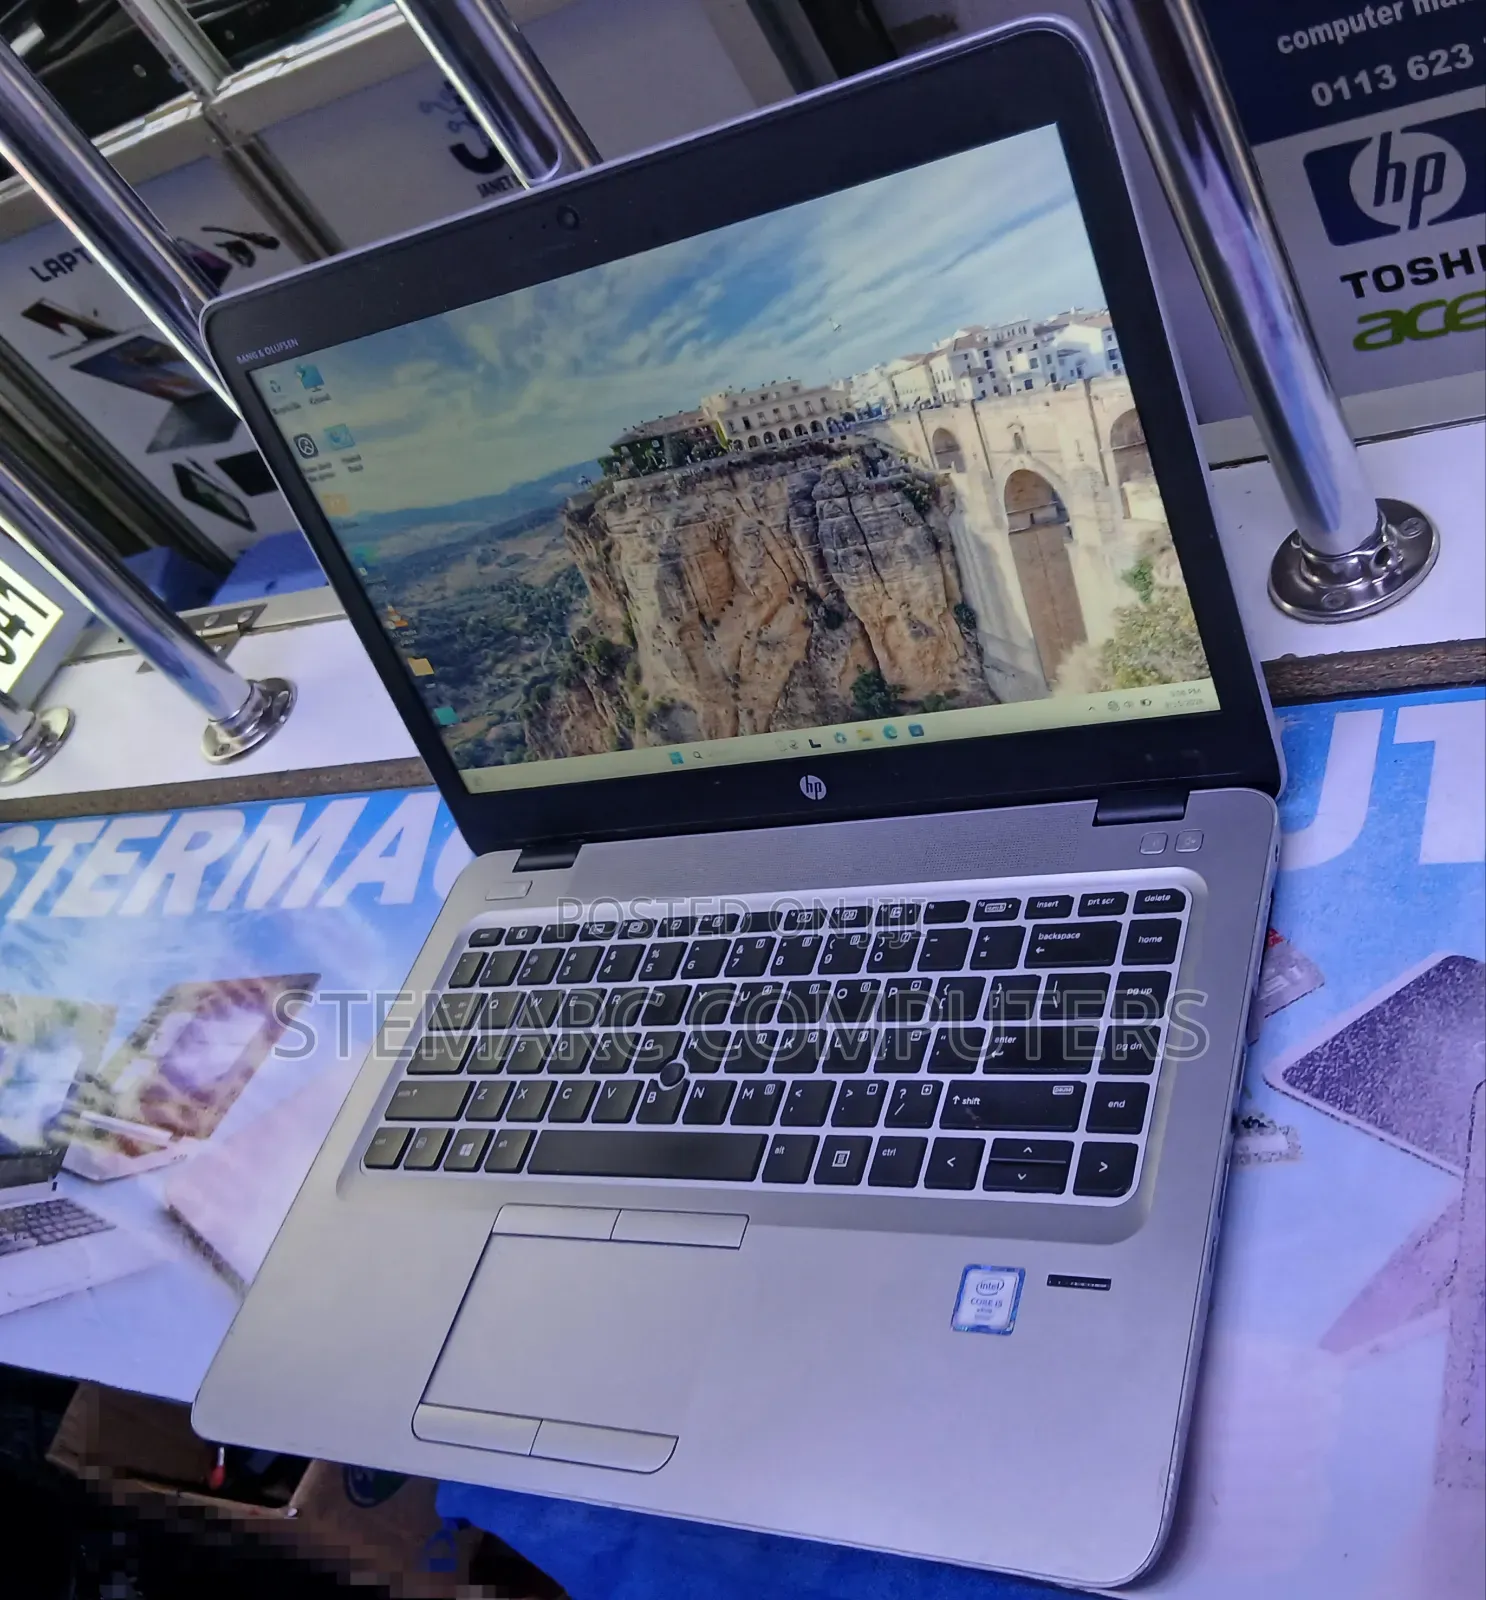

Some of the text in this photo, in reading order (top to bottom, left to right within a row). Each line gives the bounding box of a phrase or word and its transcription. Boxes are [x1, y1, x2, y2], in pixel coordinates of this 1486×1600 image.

[1277, 1, 1404, 54] computer
[1311, 43, 1474, 107] 0113 623
[1373, 131, 1446, 231] hp
[0, 791, 478, 920] STERMA
[1087, 897, 1115, 907] prt scr
[1144, 893, 1171, 903] delete
[1036, 900, 1059, 909] insert
[1038, 932, 1081, 941] backspace
[1138, 935, 1163, 944] home
[1127, 987, 1153, 996] pg up
[994, 1035, 1017, 1044] enter
[1116, 1041, 1142, 1051] pg dn
[962, 1097, 981, 1105] shift
[1108, 1100, 1125, 1108] end
[775, 1145, 785, 1154] alt
[882, 1148, 896, 1157] ctrl
